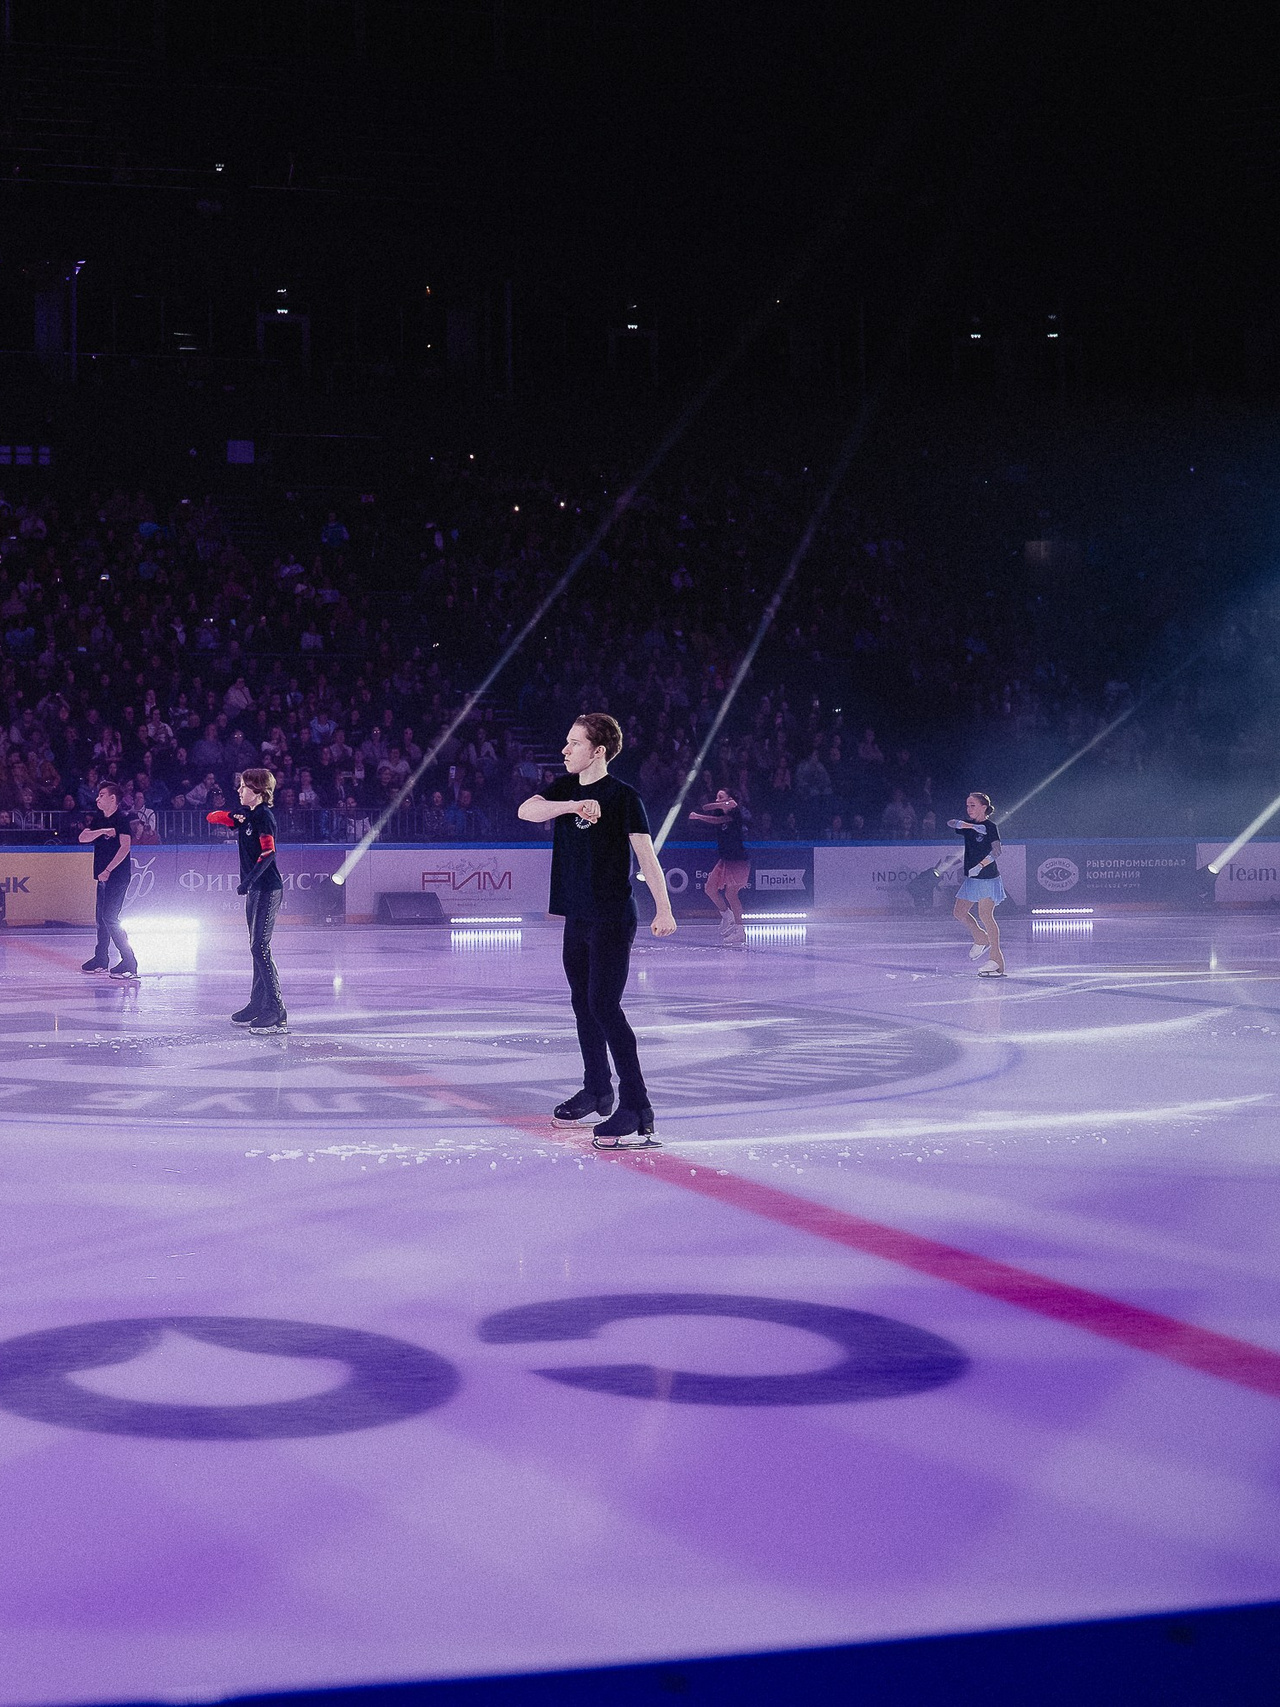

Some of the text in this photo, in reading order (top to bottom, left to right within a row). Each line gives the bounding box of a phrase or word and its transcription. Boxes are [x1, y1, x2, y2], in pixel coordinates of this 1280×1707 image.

[760, 873, 796, 886] Прайм
[872, 871, 918, 882] INDOO
[1086, 871, 1140, 879] КОМПАНИЯ
[1226, 863, 1277, 881] Team
[178, 869, 332, 893] Фигист
[70, 1089, 495, 1114] КЛУБ
